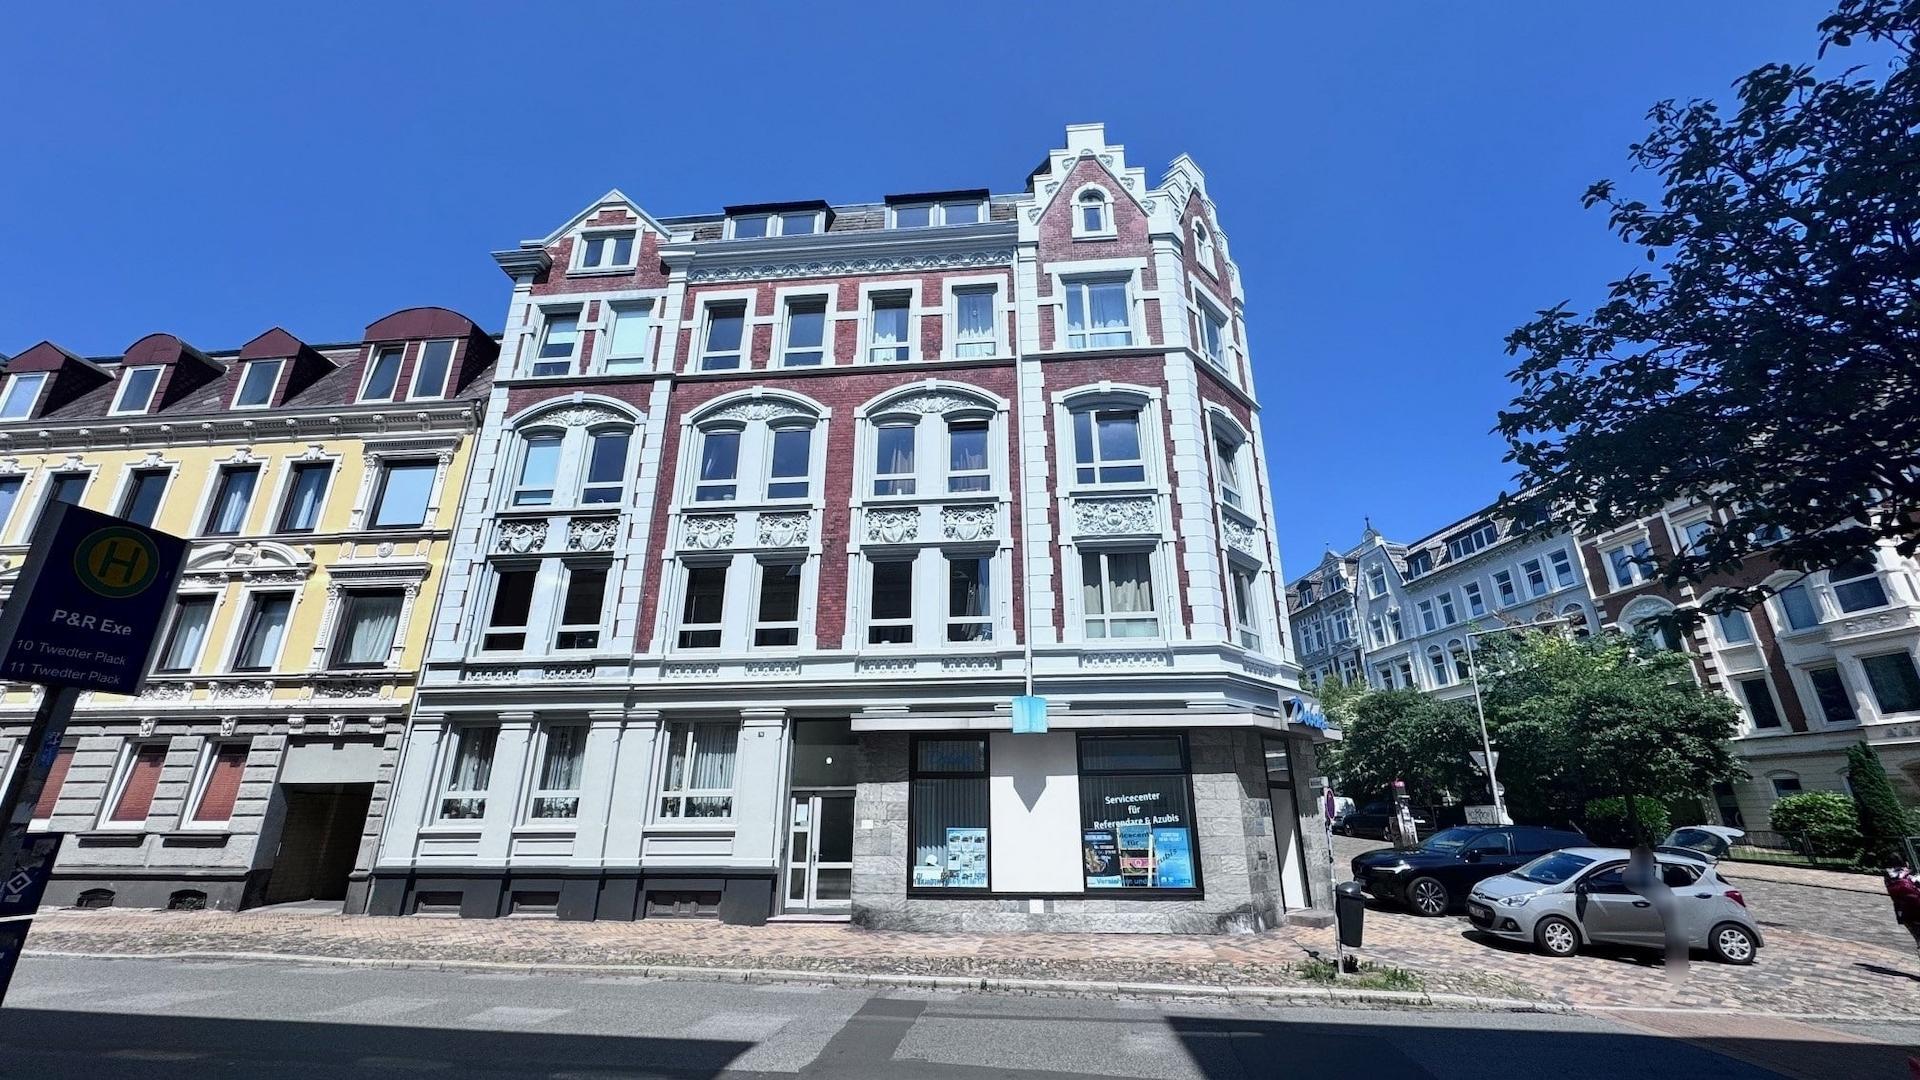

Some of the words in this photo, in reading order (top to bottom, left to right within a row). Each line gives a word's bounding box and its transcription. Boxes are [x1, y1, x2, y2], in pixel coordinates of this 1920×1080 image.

[52, 609, 96, 630] P&R
[100, 619, 132, 636] Exe
[16, 639, 34, 651] 10
[39, 642, 93, 660] Twedter
[95, 652, 127, 666] Plack
[10, 661, 24, 673] 11
[31, 663, 86, 680] Twedter
[88, 671, 120, 685] Plack
[1105, 792, 1160, 805] Servicecenter
[1128, 805, 1141, 815] für
[1094, 817, 1144, 830] Referendare
[1145, 816, 1151, 825] &
[1153, 814, 1180, 825] Azubis
